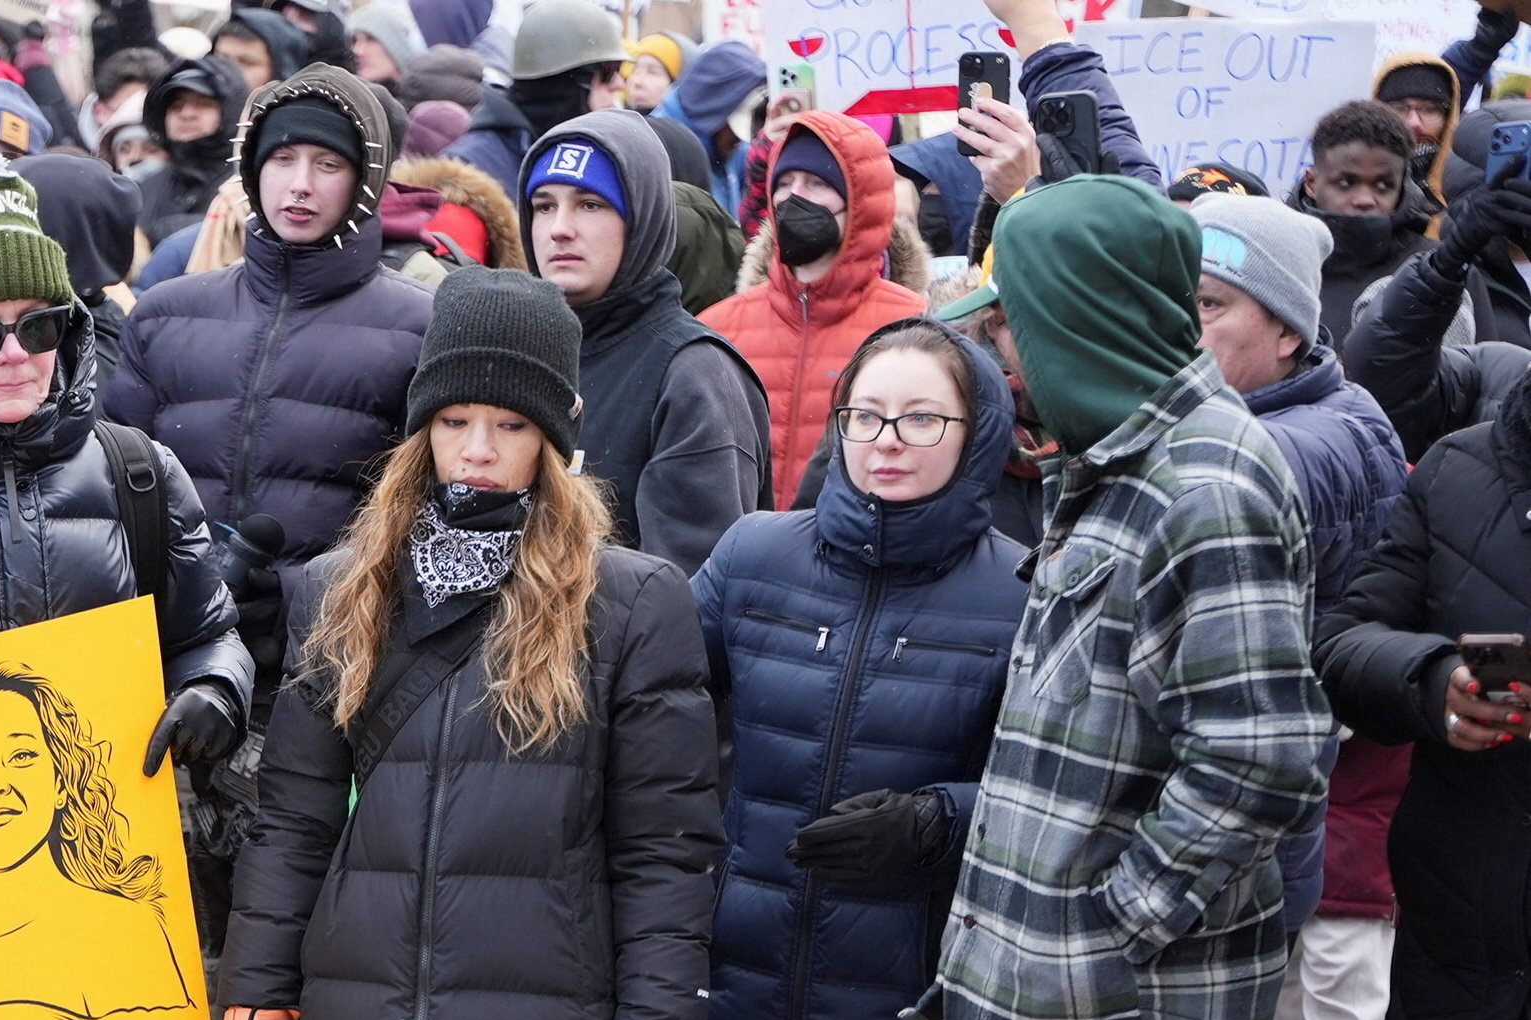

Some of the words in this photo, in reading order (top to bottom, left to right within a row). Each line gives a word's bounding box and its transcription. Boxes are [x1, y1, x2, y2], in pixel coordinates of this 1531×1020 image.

[1106, 31, 1204, 76] ICE
[1224, 32, 1335, 82] OUT
[1176, 86, 1232, 119] OF
[558, 149, 580, 169] S
